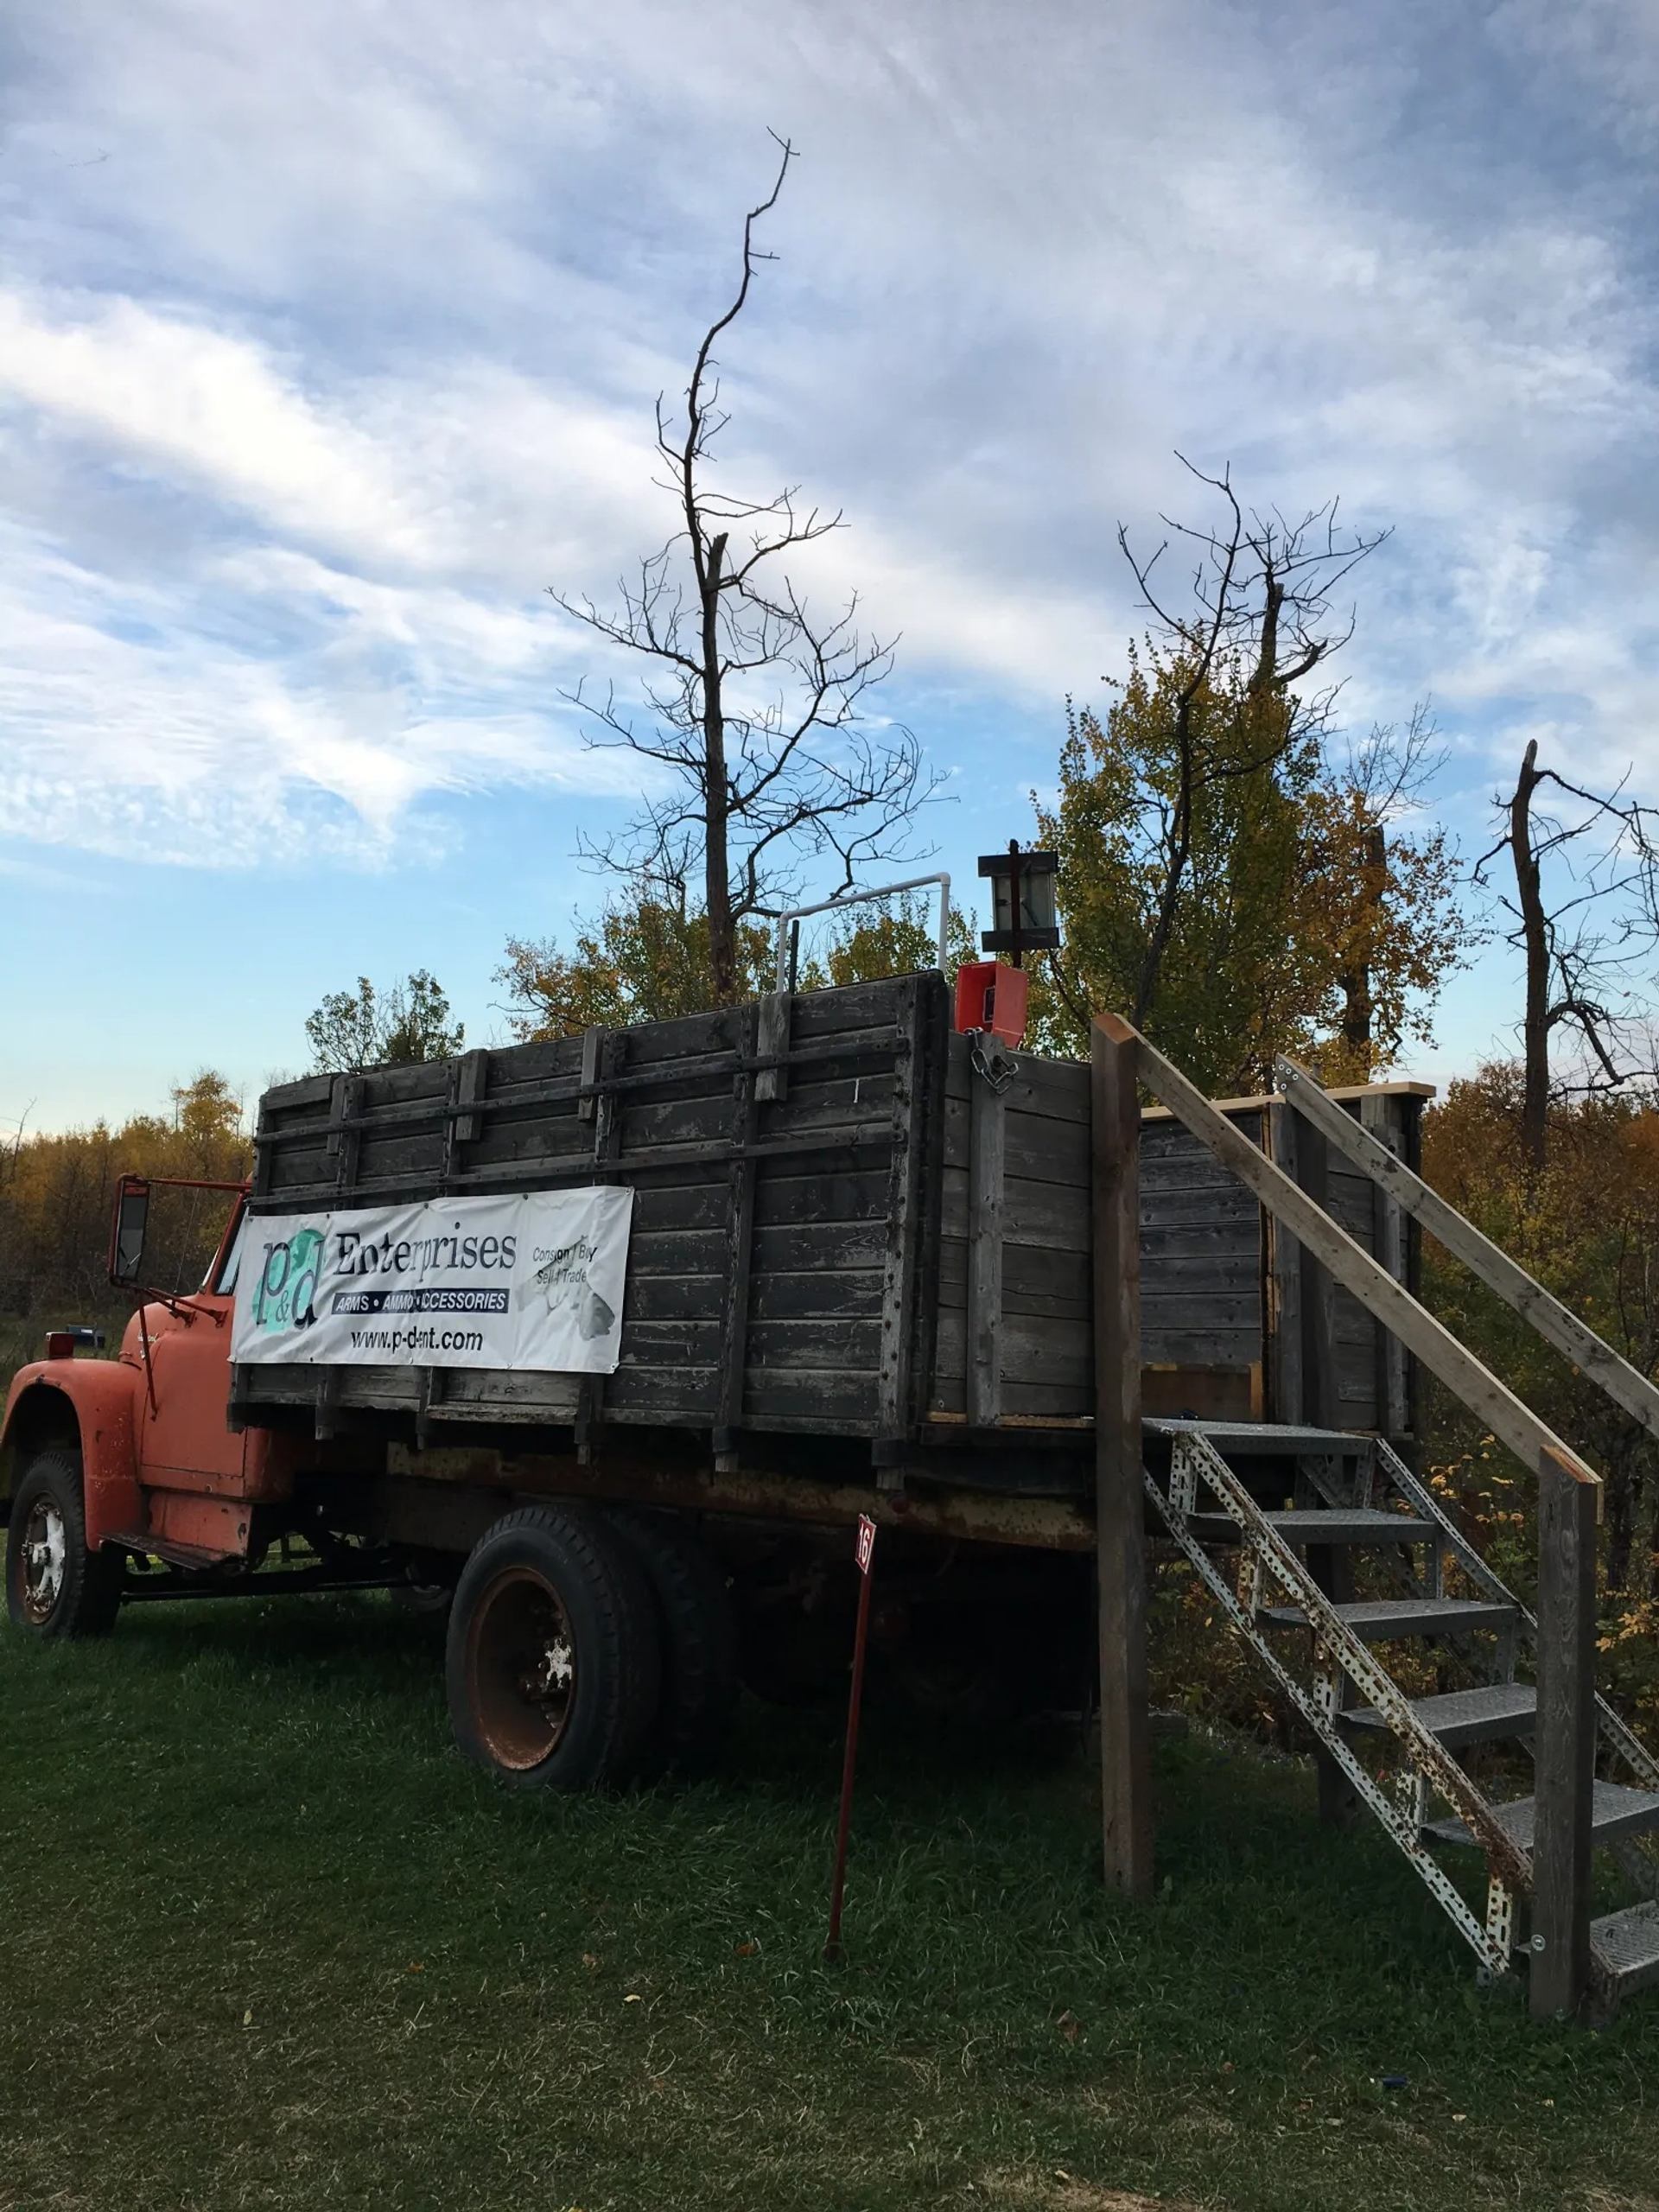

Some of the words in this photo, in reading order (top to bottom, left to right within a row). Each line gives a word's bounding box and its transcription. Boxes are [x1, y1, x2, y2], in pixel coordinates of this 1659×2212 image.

[333, 1222, 517, 1282] Enterprises
[532, 1247, 570, 1263] Consign
[579, 1244, 598, 1262] Buy
[537, 1269, 555, 1284] Sell
[563, 1268, 587, 1284] Trade
[335, 1295, 370, 1312] ARMS
[382, 1294, 414, 1311] AMMO
[858, 1522, 870, 1564] 16
